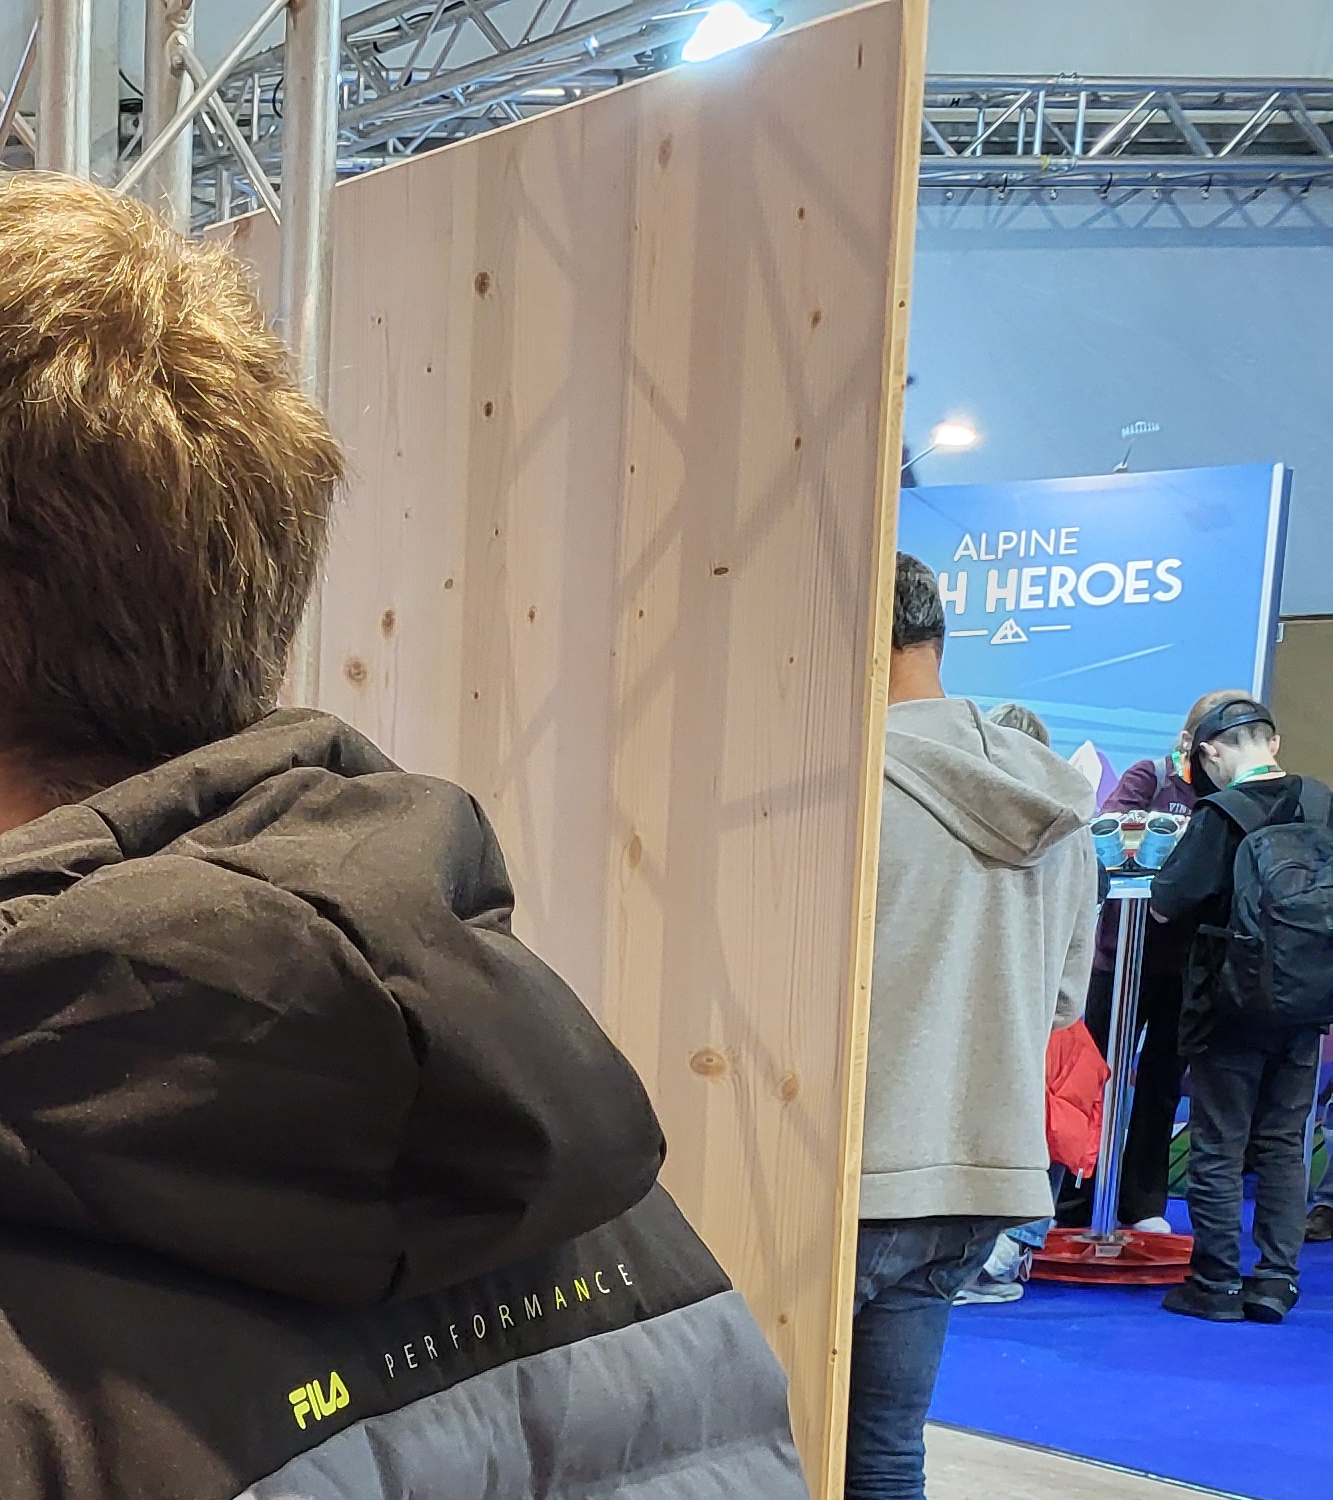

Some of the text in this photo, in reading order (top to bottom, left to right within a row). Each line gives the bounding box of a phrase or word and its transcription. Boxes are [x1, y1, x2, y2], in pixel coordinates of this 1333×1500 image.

[953, 526, 1081, 562] ALPINE
[938, 557, 1183, 615] H HEROES
[288, 1263, 634, 1430] FILA PERFORMANCE
